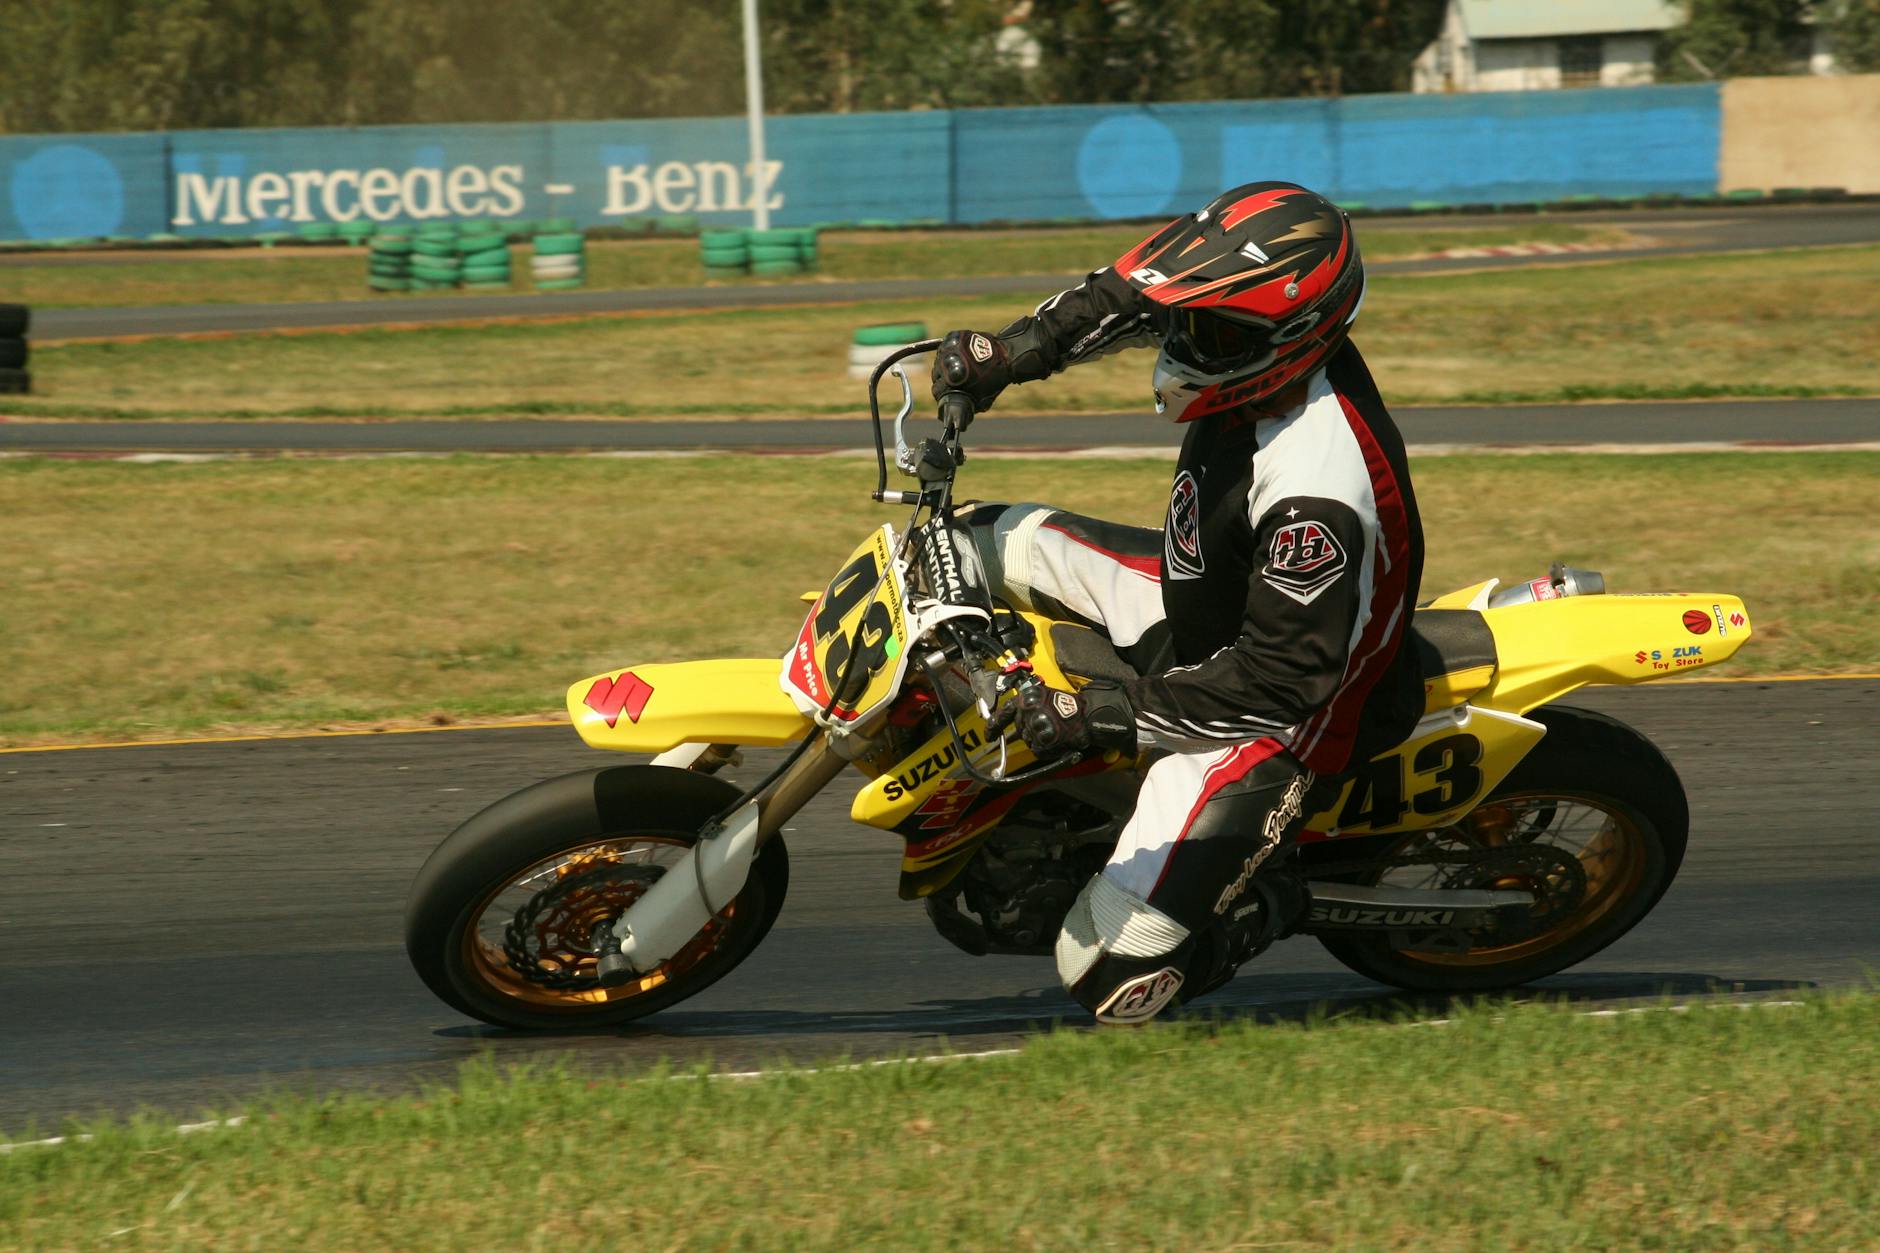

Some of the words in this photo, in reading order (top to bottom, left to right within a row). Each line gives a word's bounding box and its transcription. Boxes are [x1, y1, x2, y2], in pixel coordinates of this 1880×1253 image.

[171, 164, 525, 225] Mercedes
[600, 160, 785, 215] Benz
[1653, 662, 1670, 670] Toy
[1676, 657, 1704, 667] Store
[883, 728, 982, 802] SUZUKI
[1338, 734, 1483, 830] 43
[1310, 907, 1455, 925] SUZUKI
